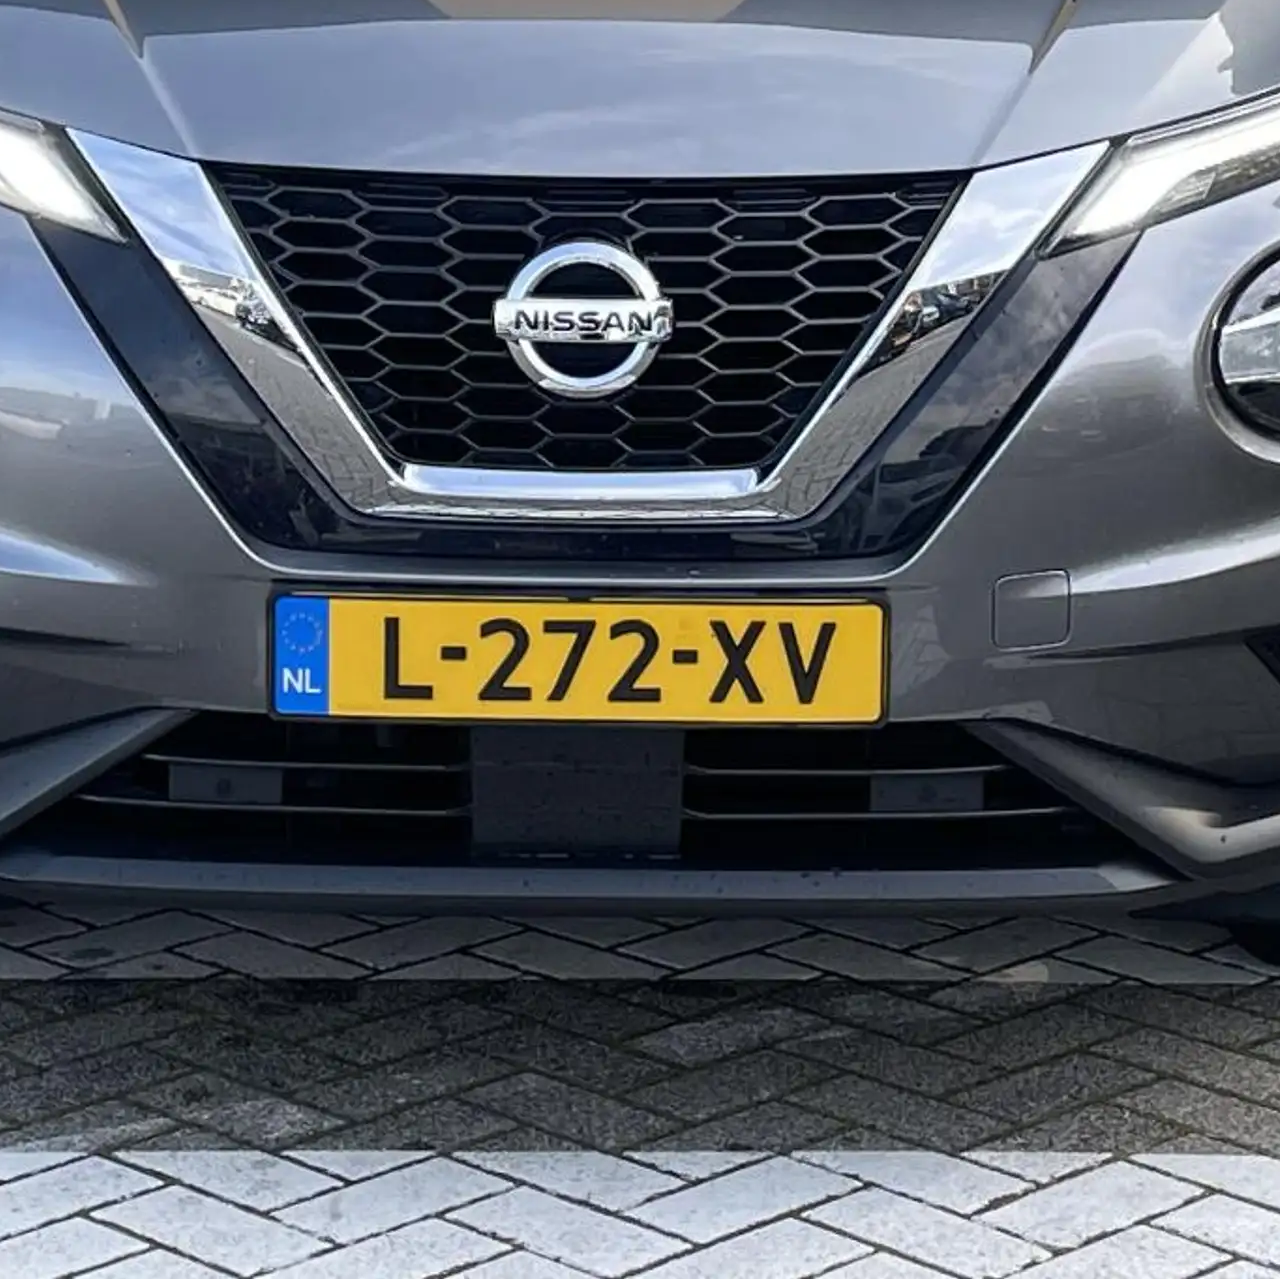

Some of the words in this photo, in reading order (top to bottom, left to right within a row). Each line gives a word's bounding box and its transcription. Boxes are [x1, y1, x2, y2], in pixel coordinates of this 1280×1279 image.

[514, 309, 652, 333] NISSAN
[383, 616, 836, 704] L-272-XV
[282, 668, 322, 694] NL
